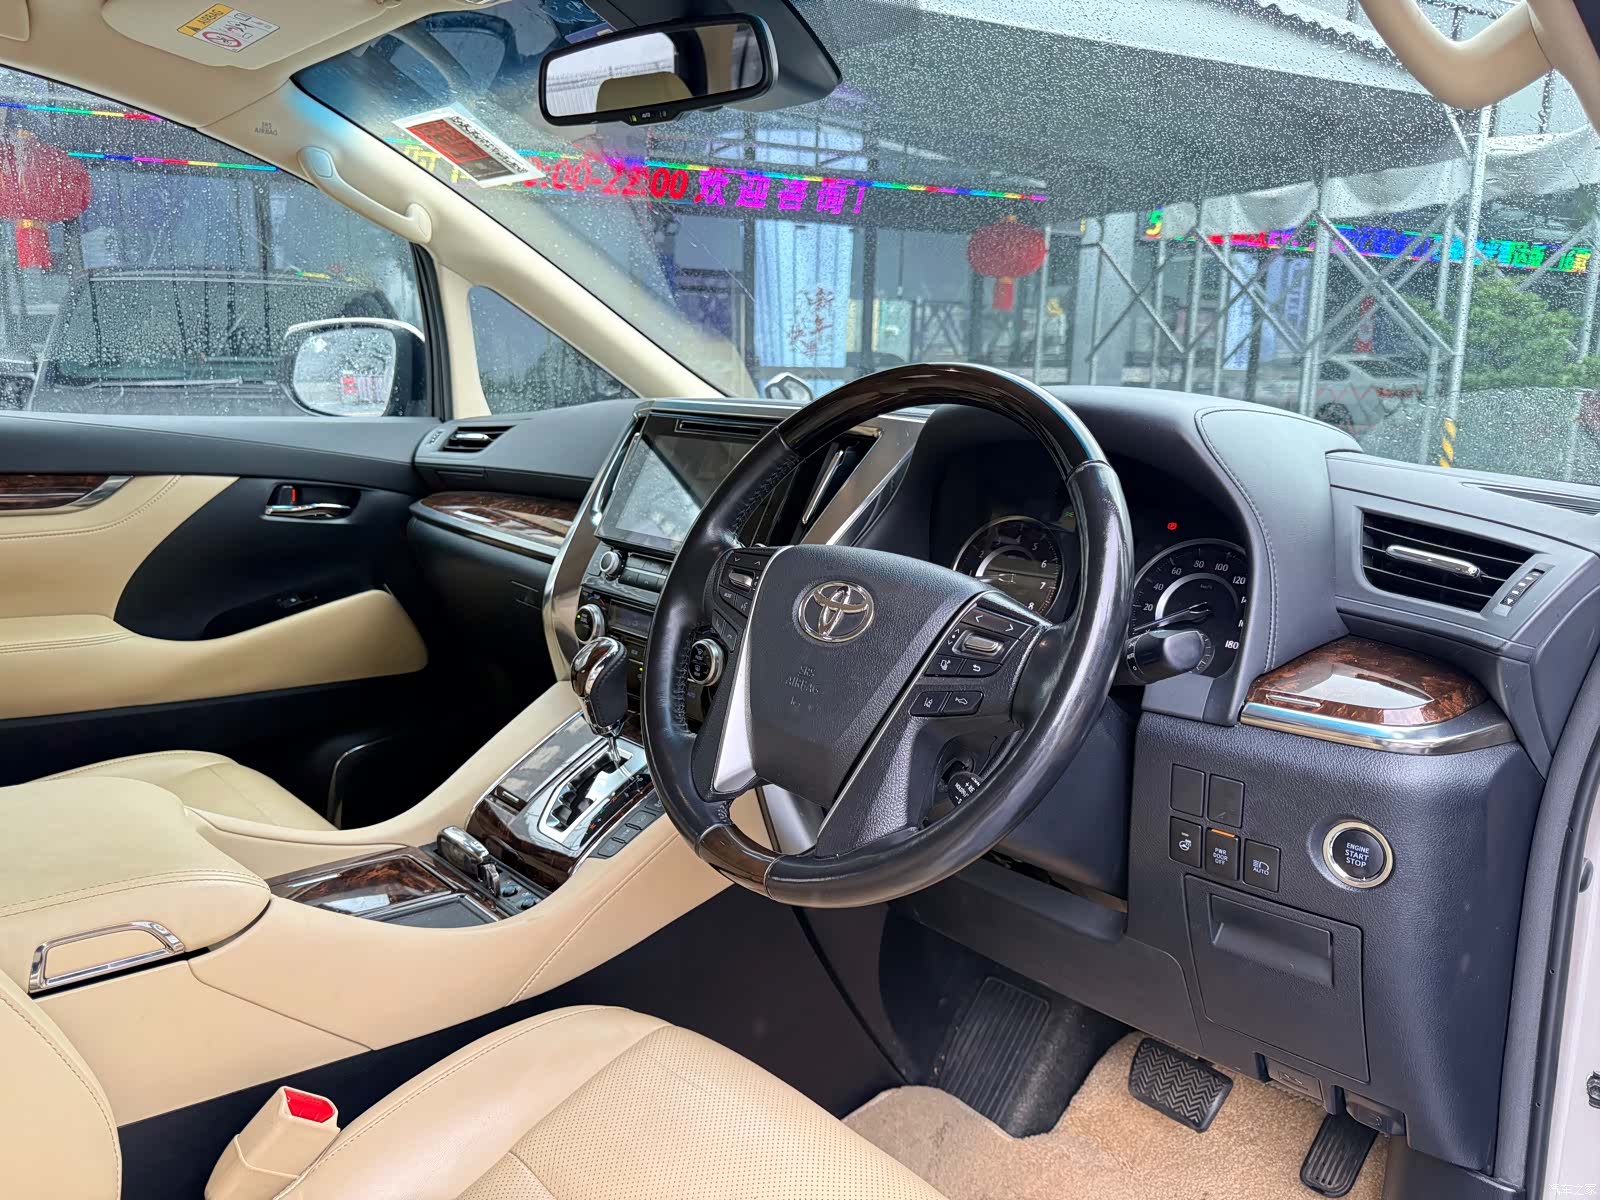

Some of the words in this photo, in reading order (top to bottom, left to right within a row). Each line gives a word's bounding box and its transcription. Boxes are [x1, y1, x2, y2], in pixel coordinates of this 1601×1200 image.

[1032, 542, 1039, 551] 5
[1041, 560, 1047, 568] 6
[1193, 560, 1205, 568] 80
[1214, 562, 1229, 572] 100
[1171, 567, 1182, 575] 60
[1232, 575, 1246, 584] 120
[1039, 581, 1046, 590] 7
[1152, 583, 1164, 591] 40
[1027, 602, 1035, 610] 8
[1143, 603, 1154, 612] 20
[1224, 639, 1240, 650] 180
[785, 676, 819, 694] AIRBAG
[1214, 847, 1227, 856] PWR
[1346, 842, 1370, 854] ENGINE
[1212, 852, 1228, 862] DOOR
[1345, 849, 1370, 861] START
[1345, 856, 1367, 868] STOP
[1252, 867, 1270, 876] AUTO
